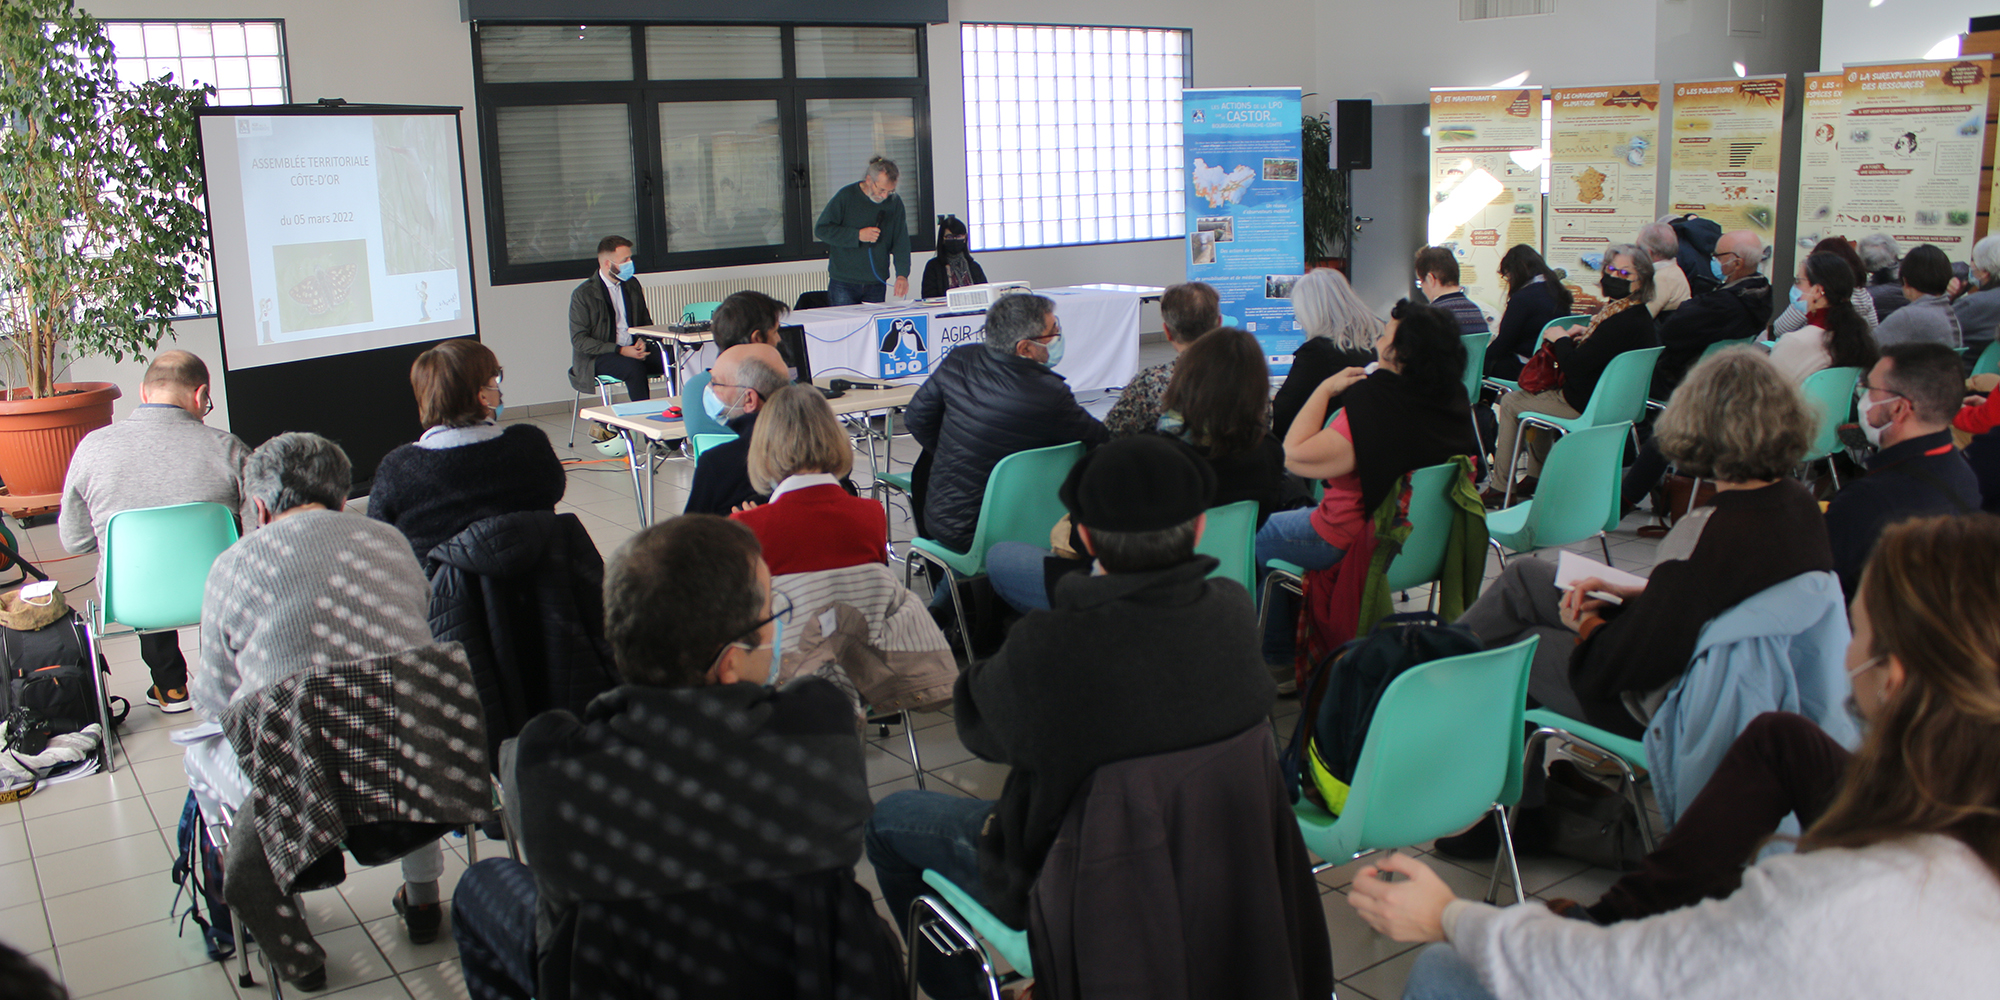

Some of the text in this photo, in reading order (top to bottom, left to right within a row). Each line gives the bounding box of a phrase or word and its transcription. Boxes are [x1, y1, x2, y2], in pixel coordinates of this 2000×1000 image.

[1860, 73, 1870, 81] LA
[1872, 69, 1940, 81] SUREXPLOITATION
[1686, 87, 1697, 95] LES
[1698, 86, 1734, 95] POLLUTIONS
[1862, 81, 1924, 91] DES RESSOURCES
[1452, 95, 1489, 103] MAINTENANT
[1571, 91, 1609, 99] CHANGEMENT
[1221, 102, 1252, 110] ACTIONS
[1268, 101, 1283, 109] LPO
[1226, 110, 1271, 122] CASTOR
[252, 155, 369, 169] ASSEMBLÉE TERRITORIALE
[290, 173, 340, 187] CÔTE-D'OR
[280, 212, 354, 226] du 05 mars 2022
[941, 325, 972, 343] AGIR
[884, 359, 922, 376] LPO
